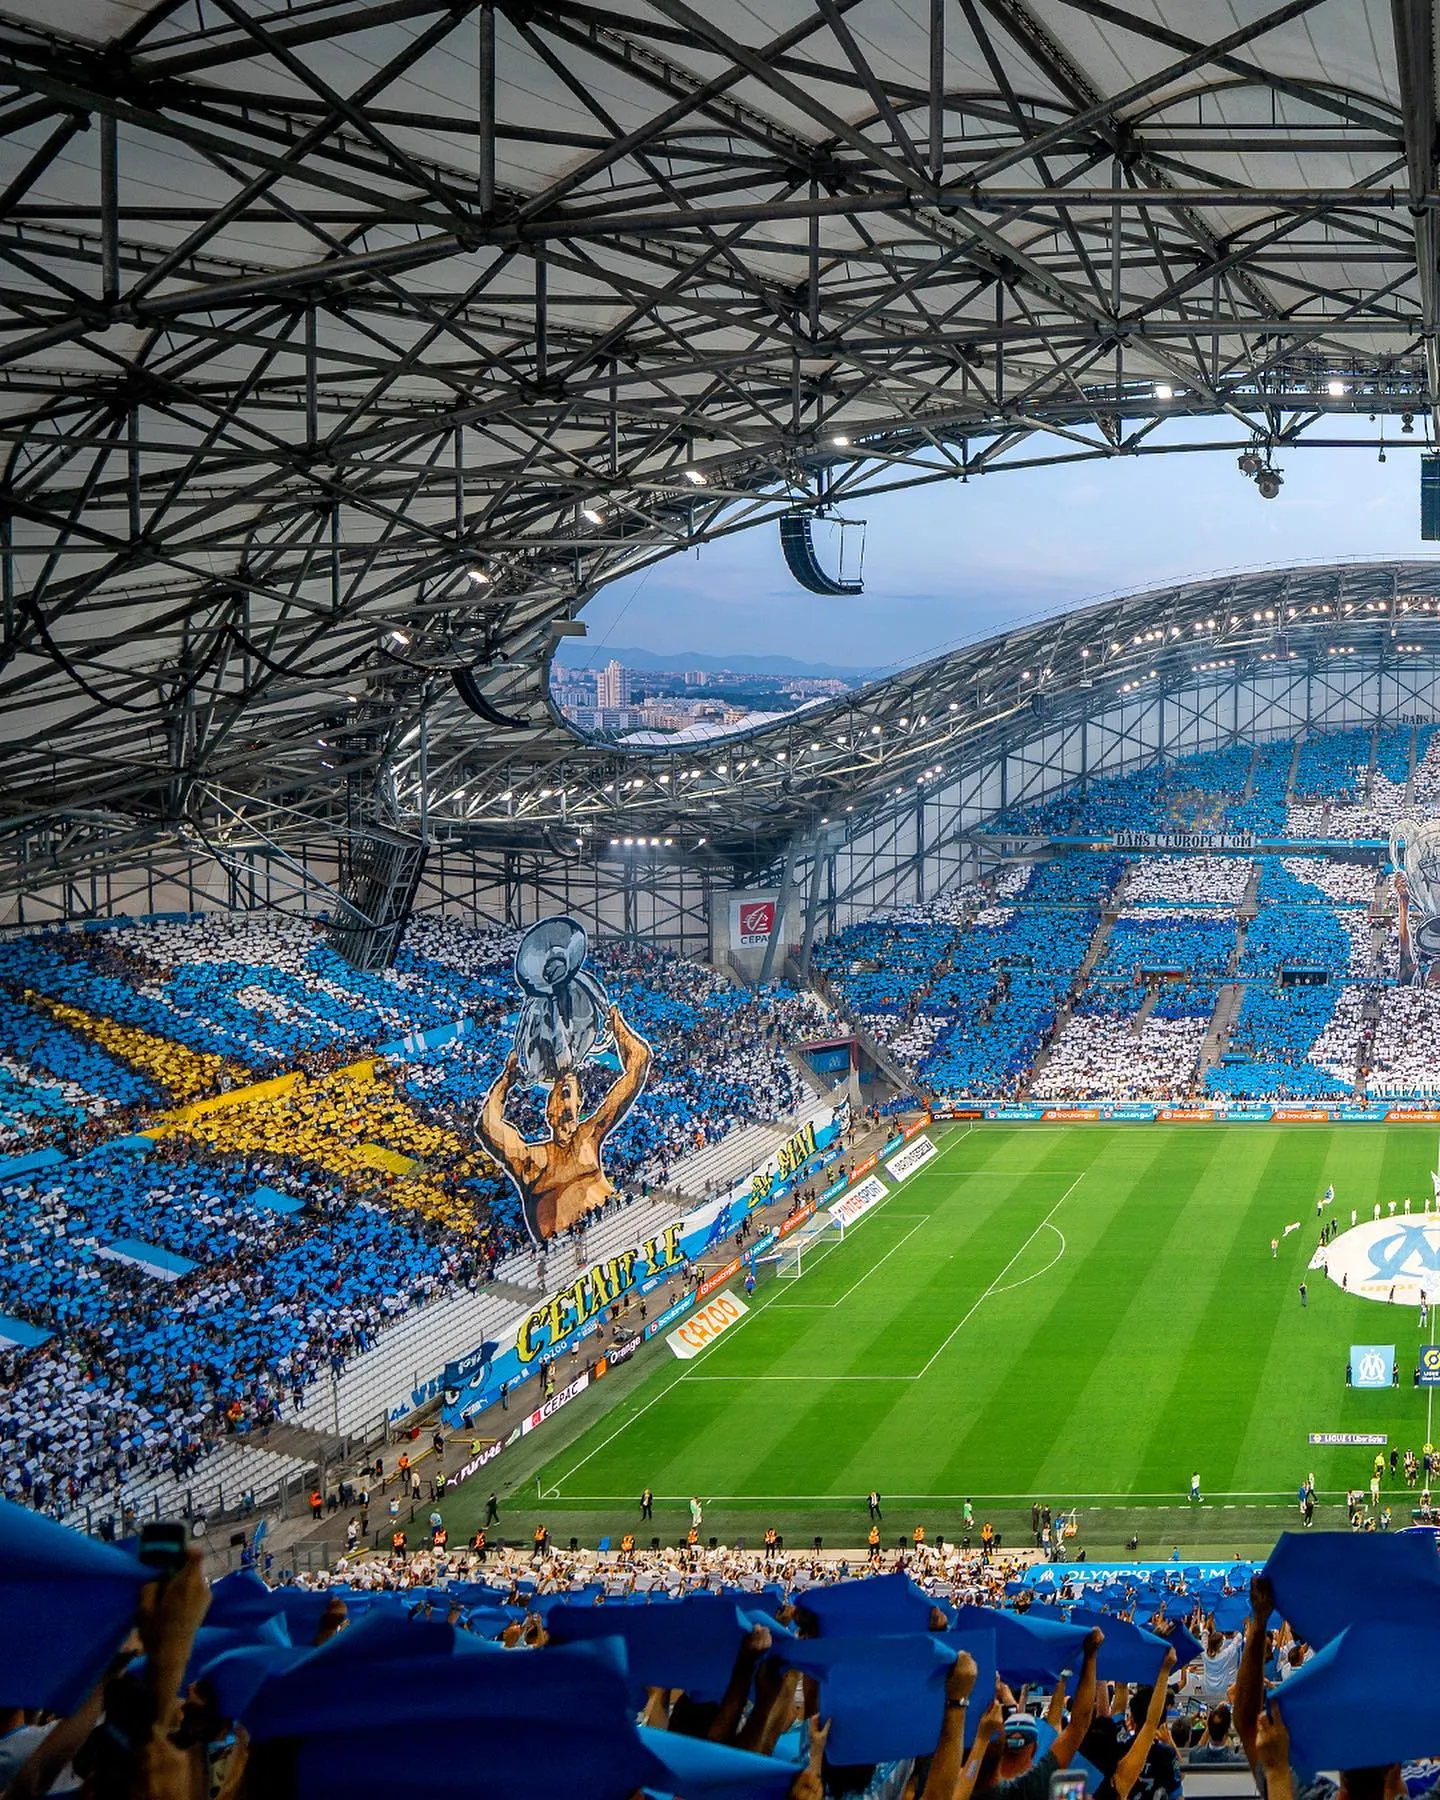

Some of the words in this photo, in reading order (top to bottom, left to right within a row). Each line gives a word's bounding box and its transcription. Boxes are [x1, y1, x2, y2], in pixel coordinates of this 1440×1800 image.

[1116, 834, 1151, 847] DANS
[740, 934, 769, 945] CEPA
[997, 1110, 1037, 1120] boulanger
[1057, 1110, 1096, 1120] boulanger
[1113, 1110, 1153, 1120] boulanger
[839, 1180, 883, 1218] INTERSPORT
[643, 1222, 687, 1279] LE
[658, 1297, 691, 1326] boulanger
[676, 1297, 740, 1349] CAZOO
[609, 1335, 641, 1364] Orange
[543, 1381, 579, 1416] CEPAC
